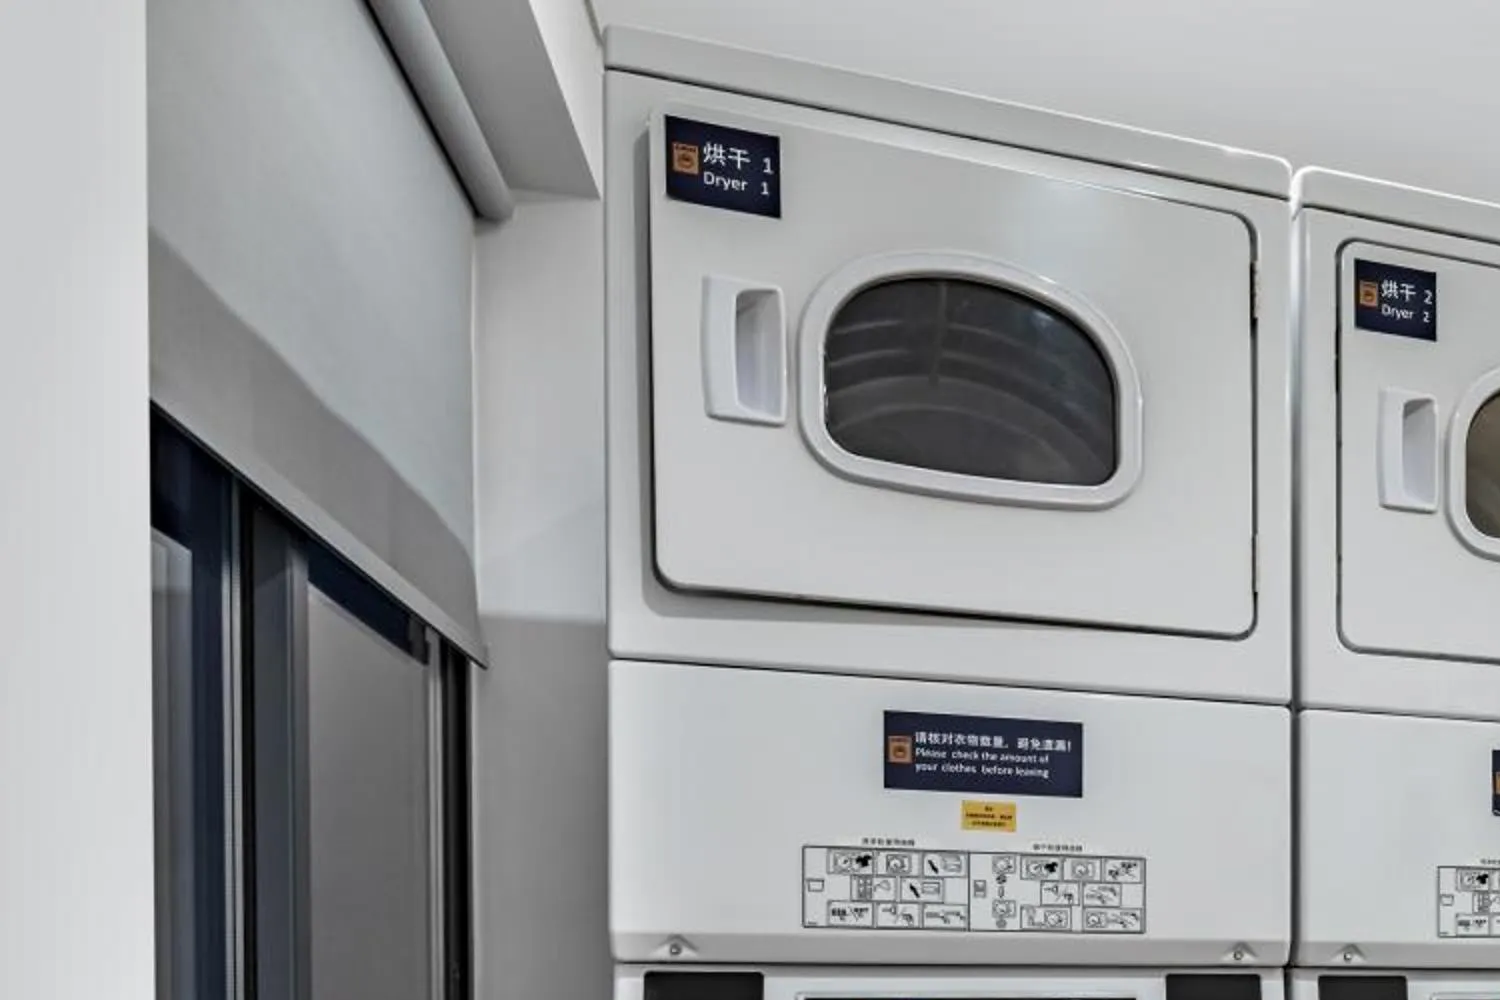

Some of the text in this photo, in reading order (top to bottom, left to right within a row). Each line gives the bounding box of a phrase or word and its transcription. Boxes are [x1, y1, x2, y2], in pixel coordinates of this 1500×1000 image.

[703, 142, 774, 174] 烘干 1
[703, 172, 770, 195] Dryer 1
[1381, 279, 1433, 305] 烘干 2
[1381, 304, 1430, 323] Dryer 2
[951, 749, 979, 761] check
[981, 750, 996, 761] the
[1039, 753, 1049, 764] of
[915, 763, 937, 774] your
[981, 763, 1014, 775] before
